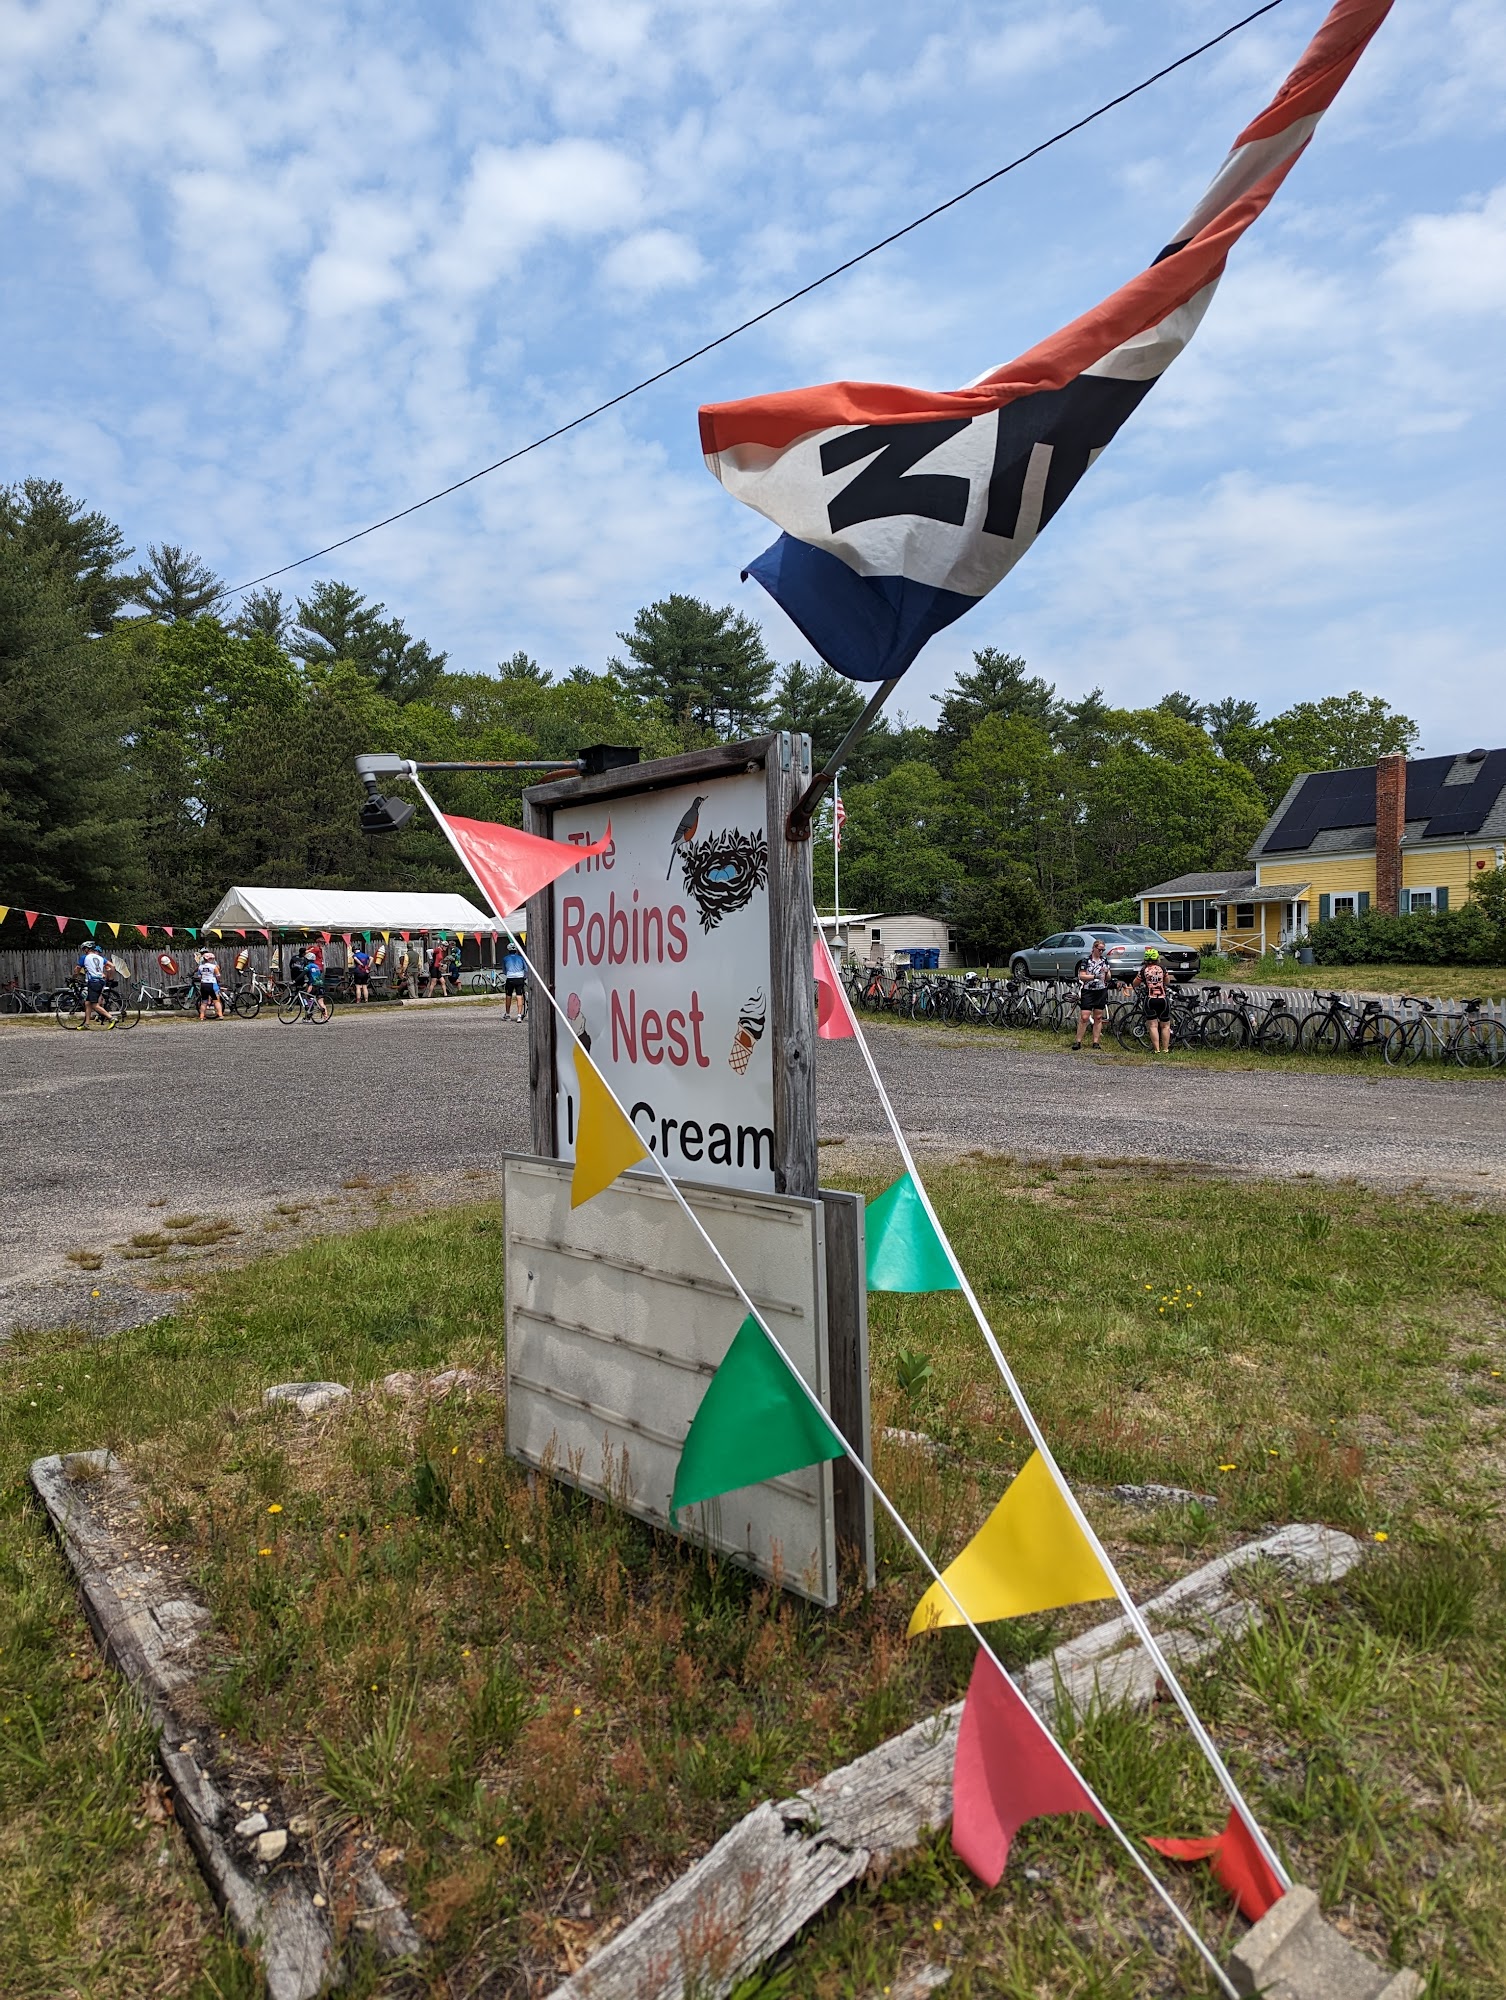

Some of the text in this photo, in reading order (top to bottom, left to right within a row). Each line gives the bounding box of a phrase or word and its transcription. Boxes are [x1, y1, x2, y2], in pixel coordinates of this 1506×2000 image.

[568, 831, 616, 873] The
[562, 889, 688, 966] Robins
[610, 988, 710, 1068] Nest
